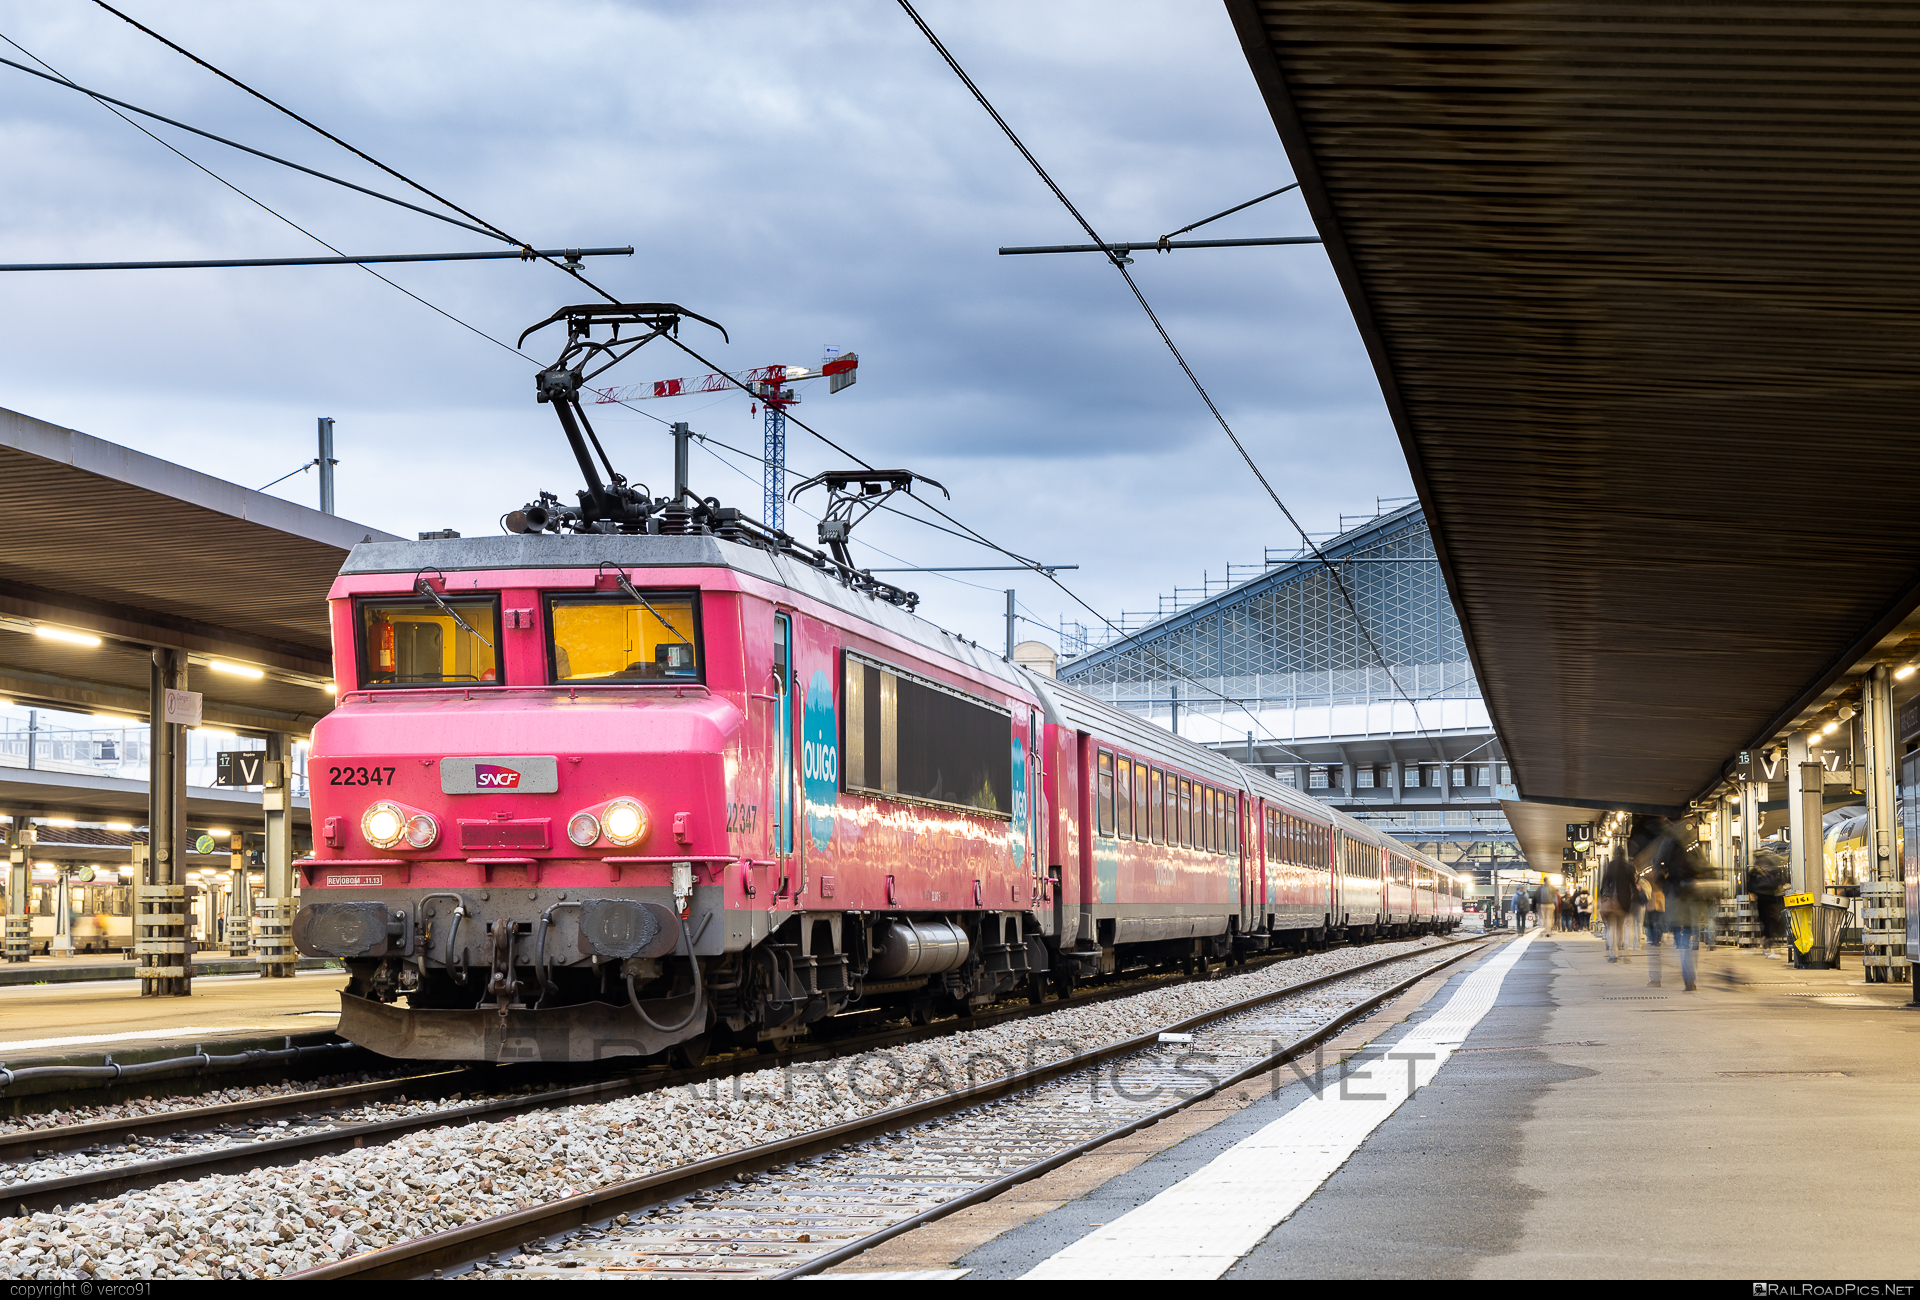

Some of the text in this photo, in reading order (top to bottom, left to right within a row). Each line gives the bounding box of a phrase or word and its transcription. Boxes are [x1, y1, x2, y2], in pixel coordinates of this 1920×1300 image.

[219, 757, 231, 766] 17
[1738, 754, 1750, 763] 15
[239, 758, 260, 784] V
[1760, 756, 1780, 780] V
[329, 766, 396, 786] 22347
[477, 773, 518, 786] SNCF
[1579, 828, 1589, 840] U
